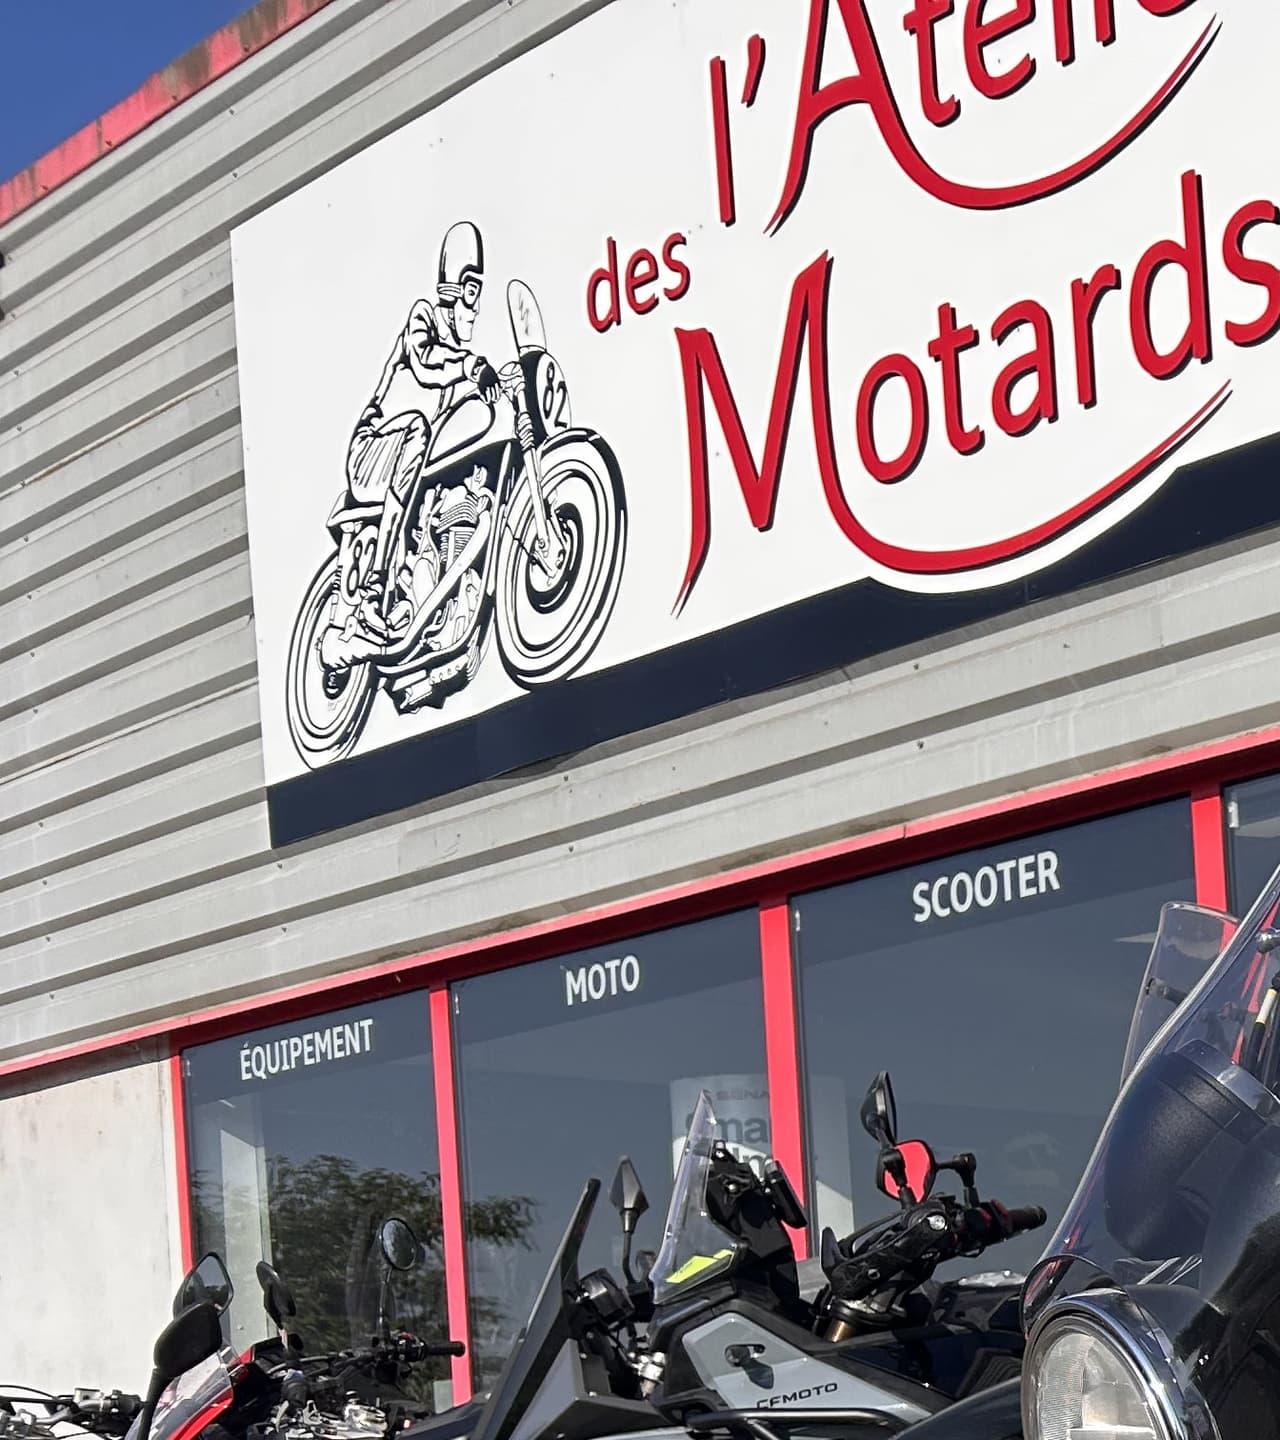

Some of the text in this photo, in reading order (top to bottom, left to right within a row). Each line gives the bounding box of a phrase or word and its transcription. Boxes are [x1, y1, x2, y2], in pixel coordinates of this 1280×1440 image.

[709, 0, 1224, 238] l'Ate
[587, 231, 690, 332] des
[912, 850, 1061, 923] SCOOTER
[564, 954, 641, 1005] MOTO
[239, 1018, 374, 1081] ÉQUIPEMENT
[756, 1382, 838, 1409] CFMOTO
